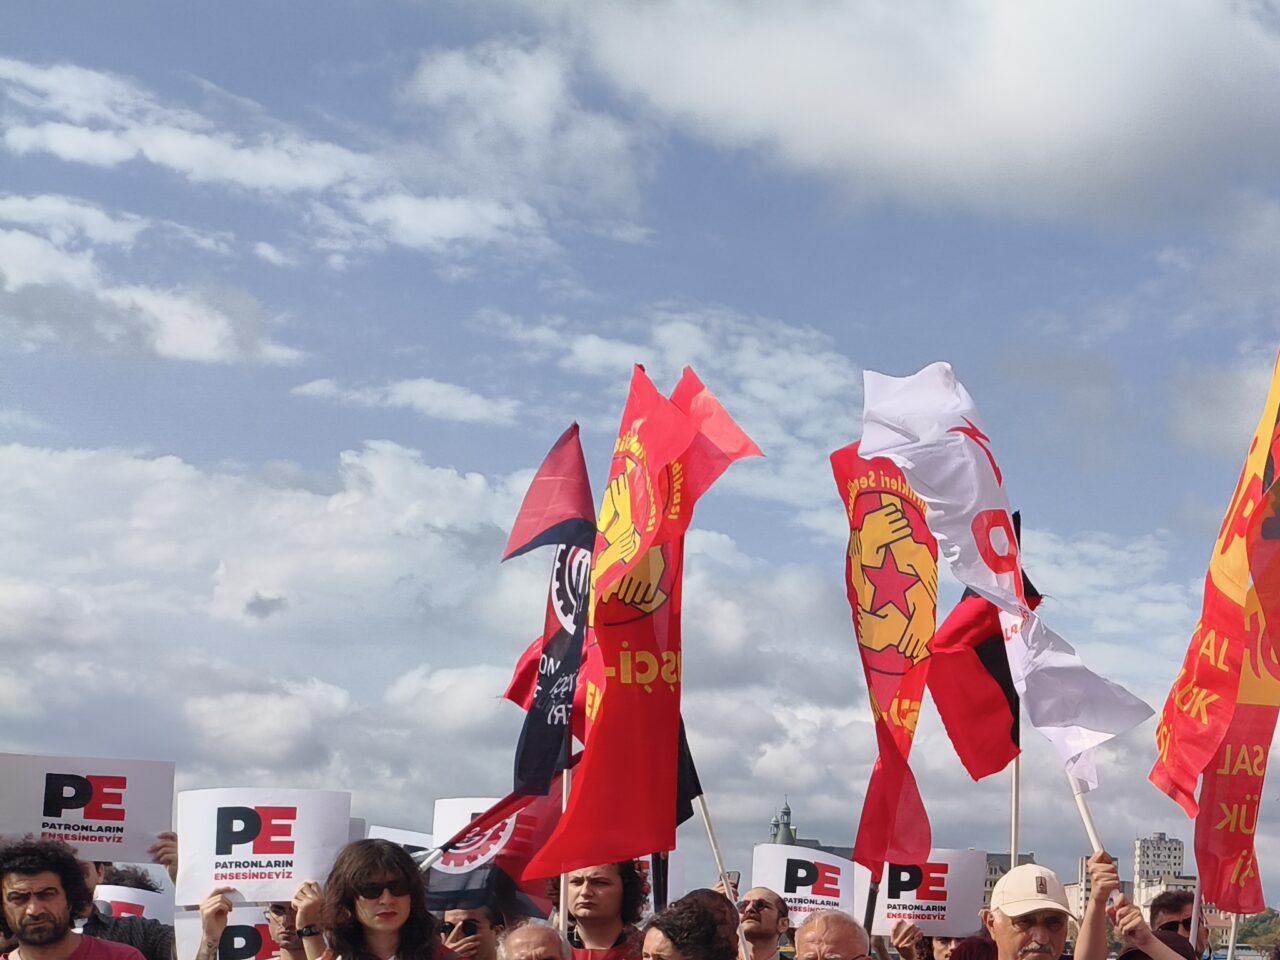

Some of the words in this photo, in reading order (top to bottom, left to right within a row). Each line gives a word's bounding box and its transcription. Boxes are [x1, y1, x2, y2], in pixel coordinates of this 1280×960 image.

[43, 773, 127, 821] PE
[42, 822, 124, 833] PATRONLARIN
[215, 806, 297, 855] PE
[214, 860, 293, 869] PATRONLARIN
[214, 870, 293, 881] ENSESİNDEYİZ
[784, 858, 841, 898] PE
[888, 863, 948, 901] PE
[784, 897, 839, 907] PATRONLARIN
[887, 904, 946, 912] PATRONLARIN
[887, 911, 945, 921] ENSESİNDEYİZ
